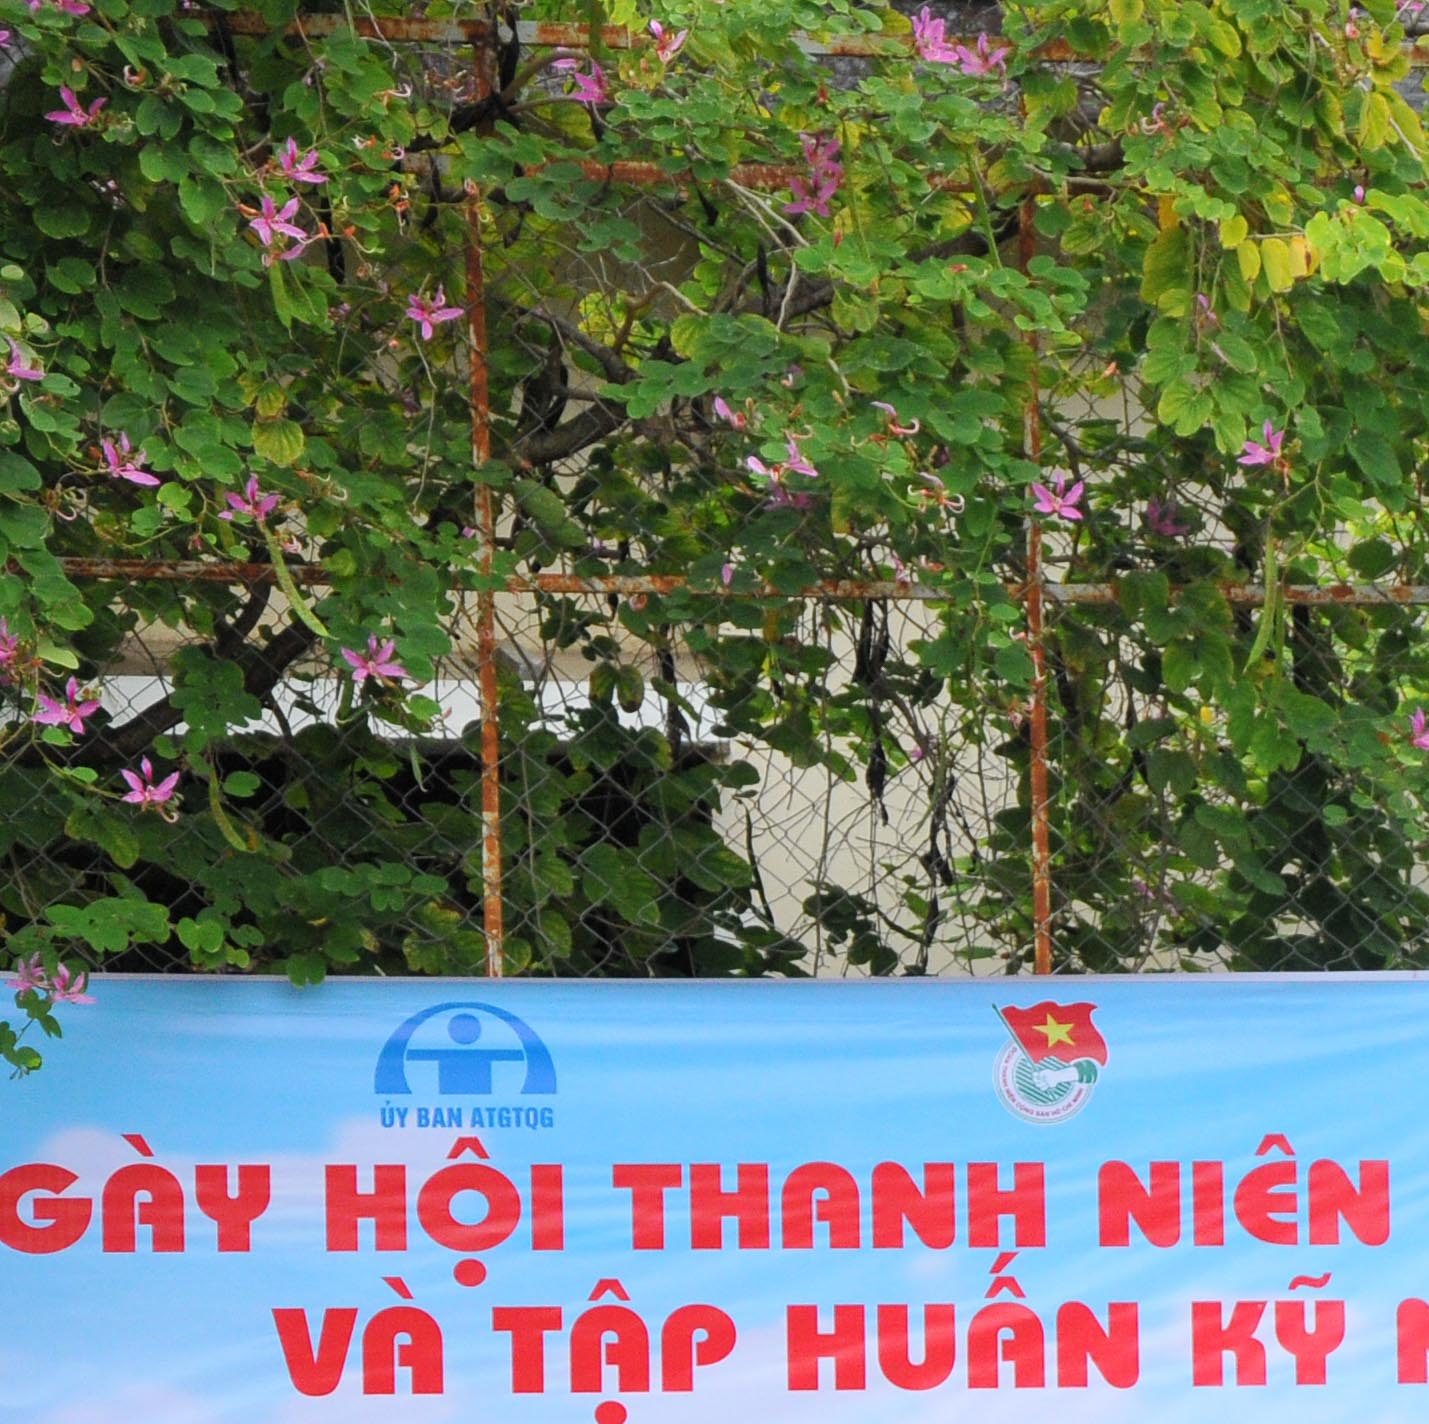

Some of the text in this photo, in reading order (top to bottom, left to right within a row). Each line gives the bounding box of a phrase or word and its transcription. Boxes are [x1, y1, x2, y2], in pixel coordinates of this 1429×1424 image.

[416, 1106, 463, 1128] BAN
[470, 1106, 554, 1130] ATGTQG
[326, 1137, 564, 1287] HỘI
[613, 1162, 1046, 1250] THANH
[1098, 1134, 1390, 1247] NIÊN
[272, 1277, 444, 1397] VÀ
[787, 1252, 1140, 1391] HUẤN
[1192, 1273, 1346, 1387] KỸ
